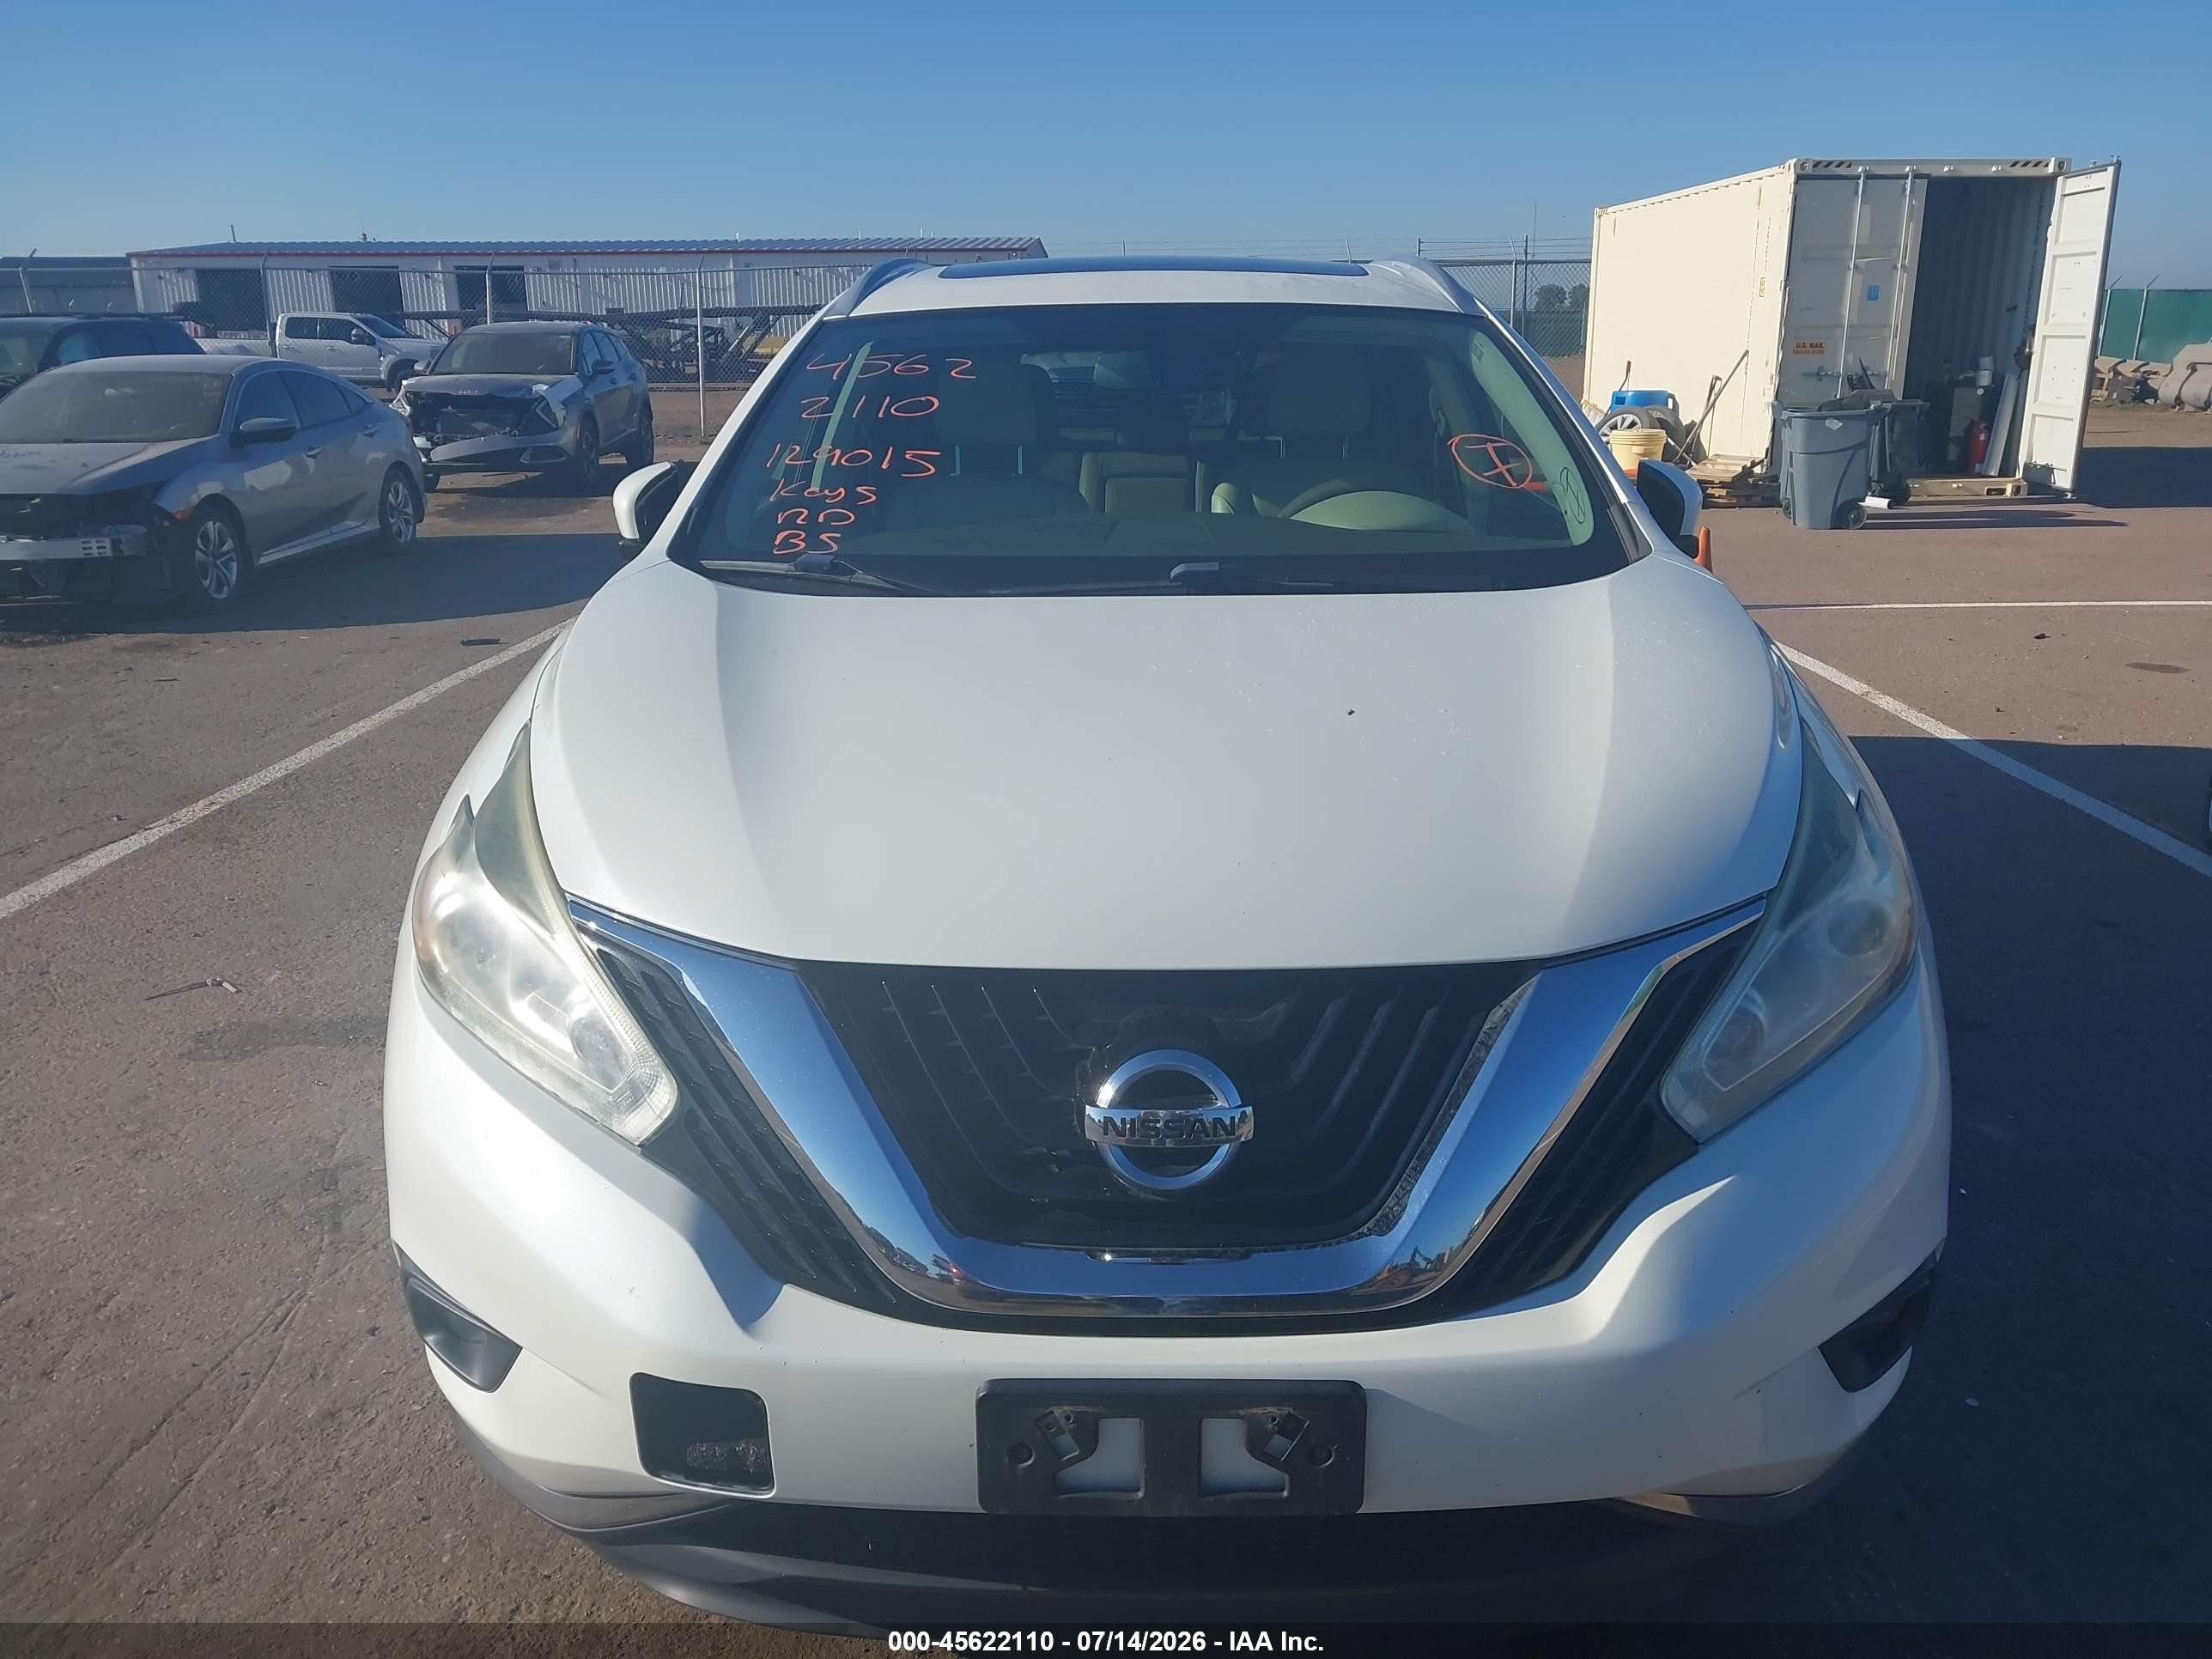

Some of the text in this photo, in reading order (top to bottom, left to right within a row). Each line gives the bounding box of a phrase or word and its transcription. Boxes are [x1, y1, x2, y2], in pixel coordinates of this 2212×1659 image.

[805, 353, 977, 380] 4562
[799, 395, 940, 418] 2110
[1103, 1115, 1237, 1139] NISSAN
